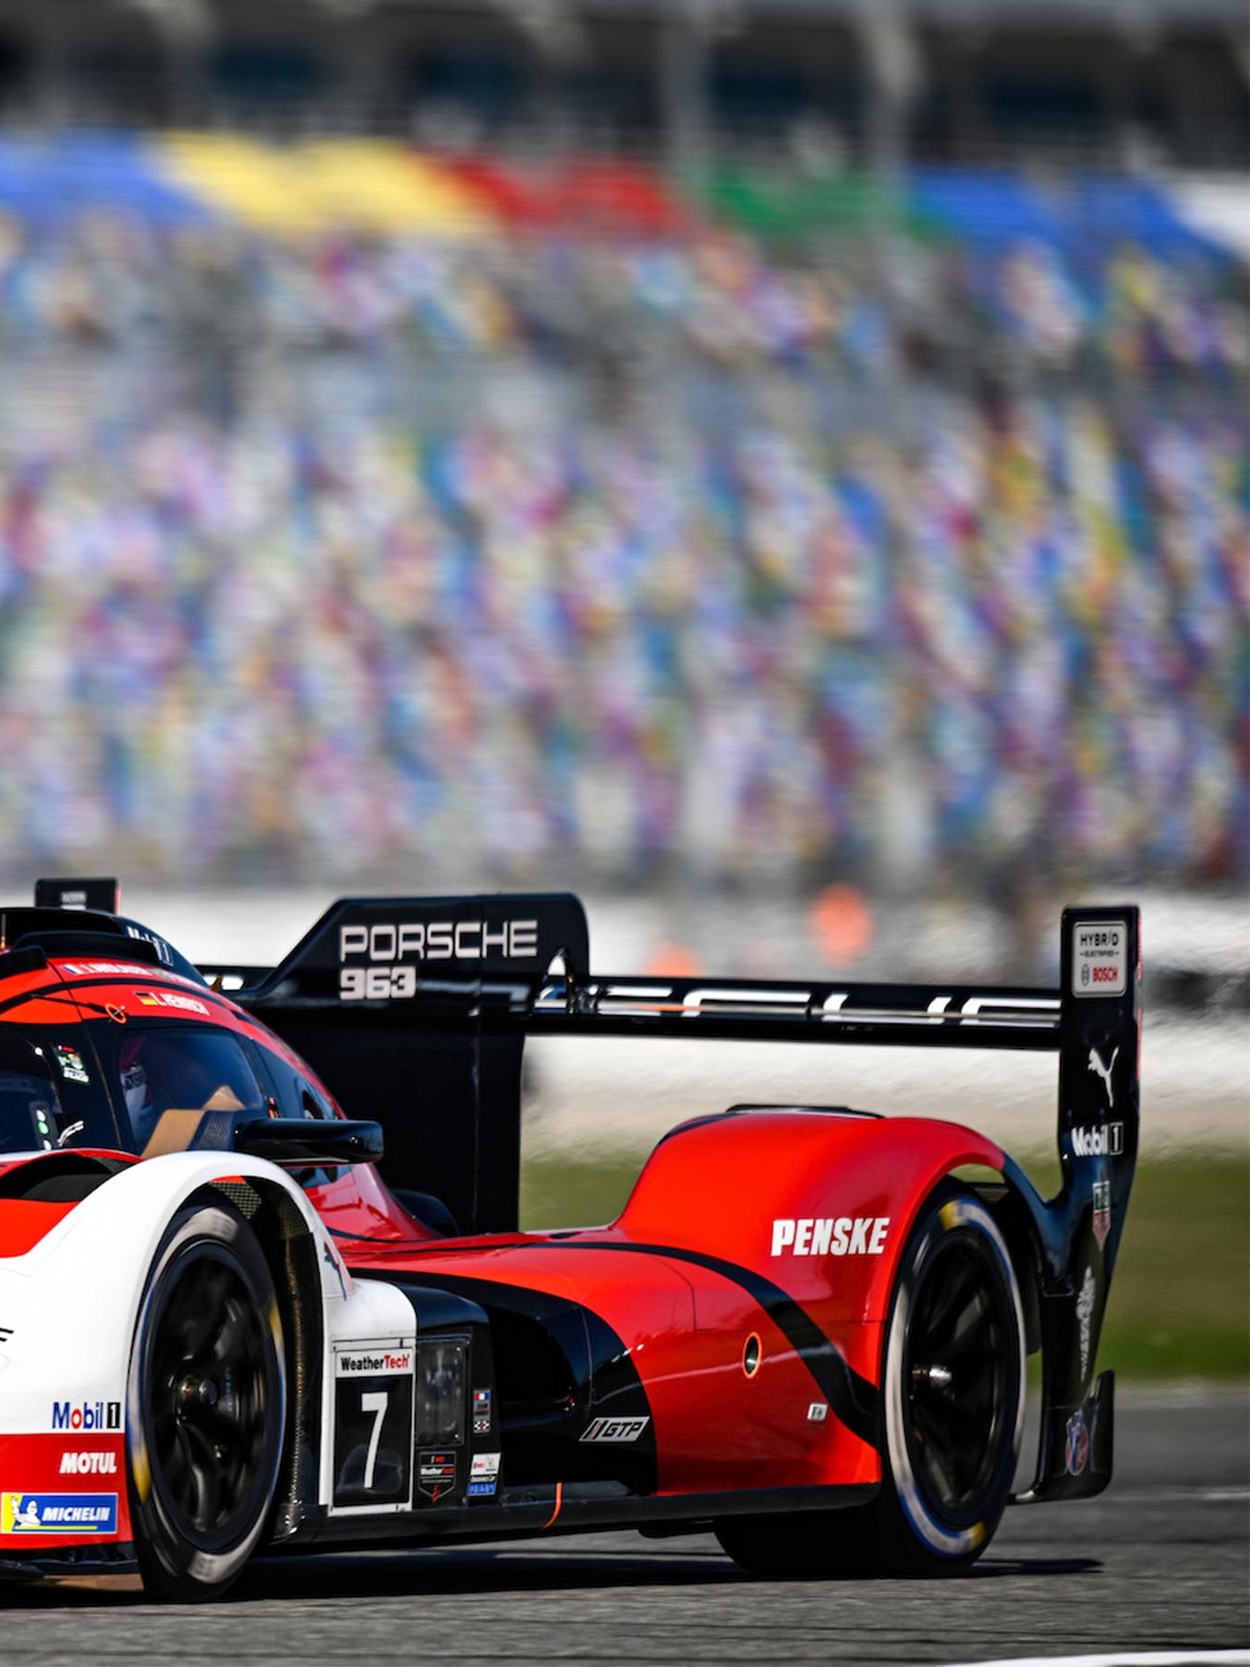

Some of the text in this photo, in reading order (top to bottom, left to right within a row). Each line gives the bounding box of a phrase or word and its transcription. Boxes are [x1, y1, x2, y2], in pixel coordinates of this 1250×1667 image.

[339, 919, 539, 962] PORSCHE
[338, 965, 416, 1001] 963
[1092, 966, 1119, 983] BOSCH
[1071, 1124, 1108, 1157] Mobil
[771, 1216, 891, 1258] PENSKE
[339, 1353, 410, 1372] WeatherTech
[52, 1402, 120, 1430] Mobil 1
[602, 1420, 645, 1438] GTP
[361, 1391, 389, 1489] 7
[58, 1452, 118, 1475] MOTUL
[41, 1506, 112, 1523] MICHELIN
